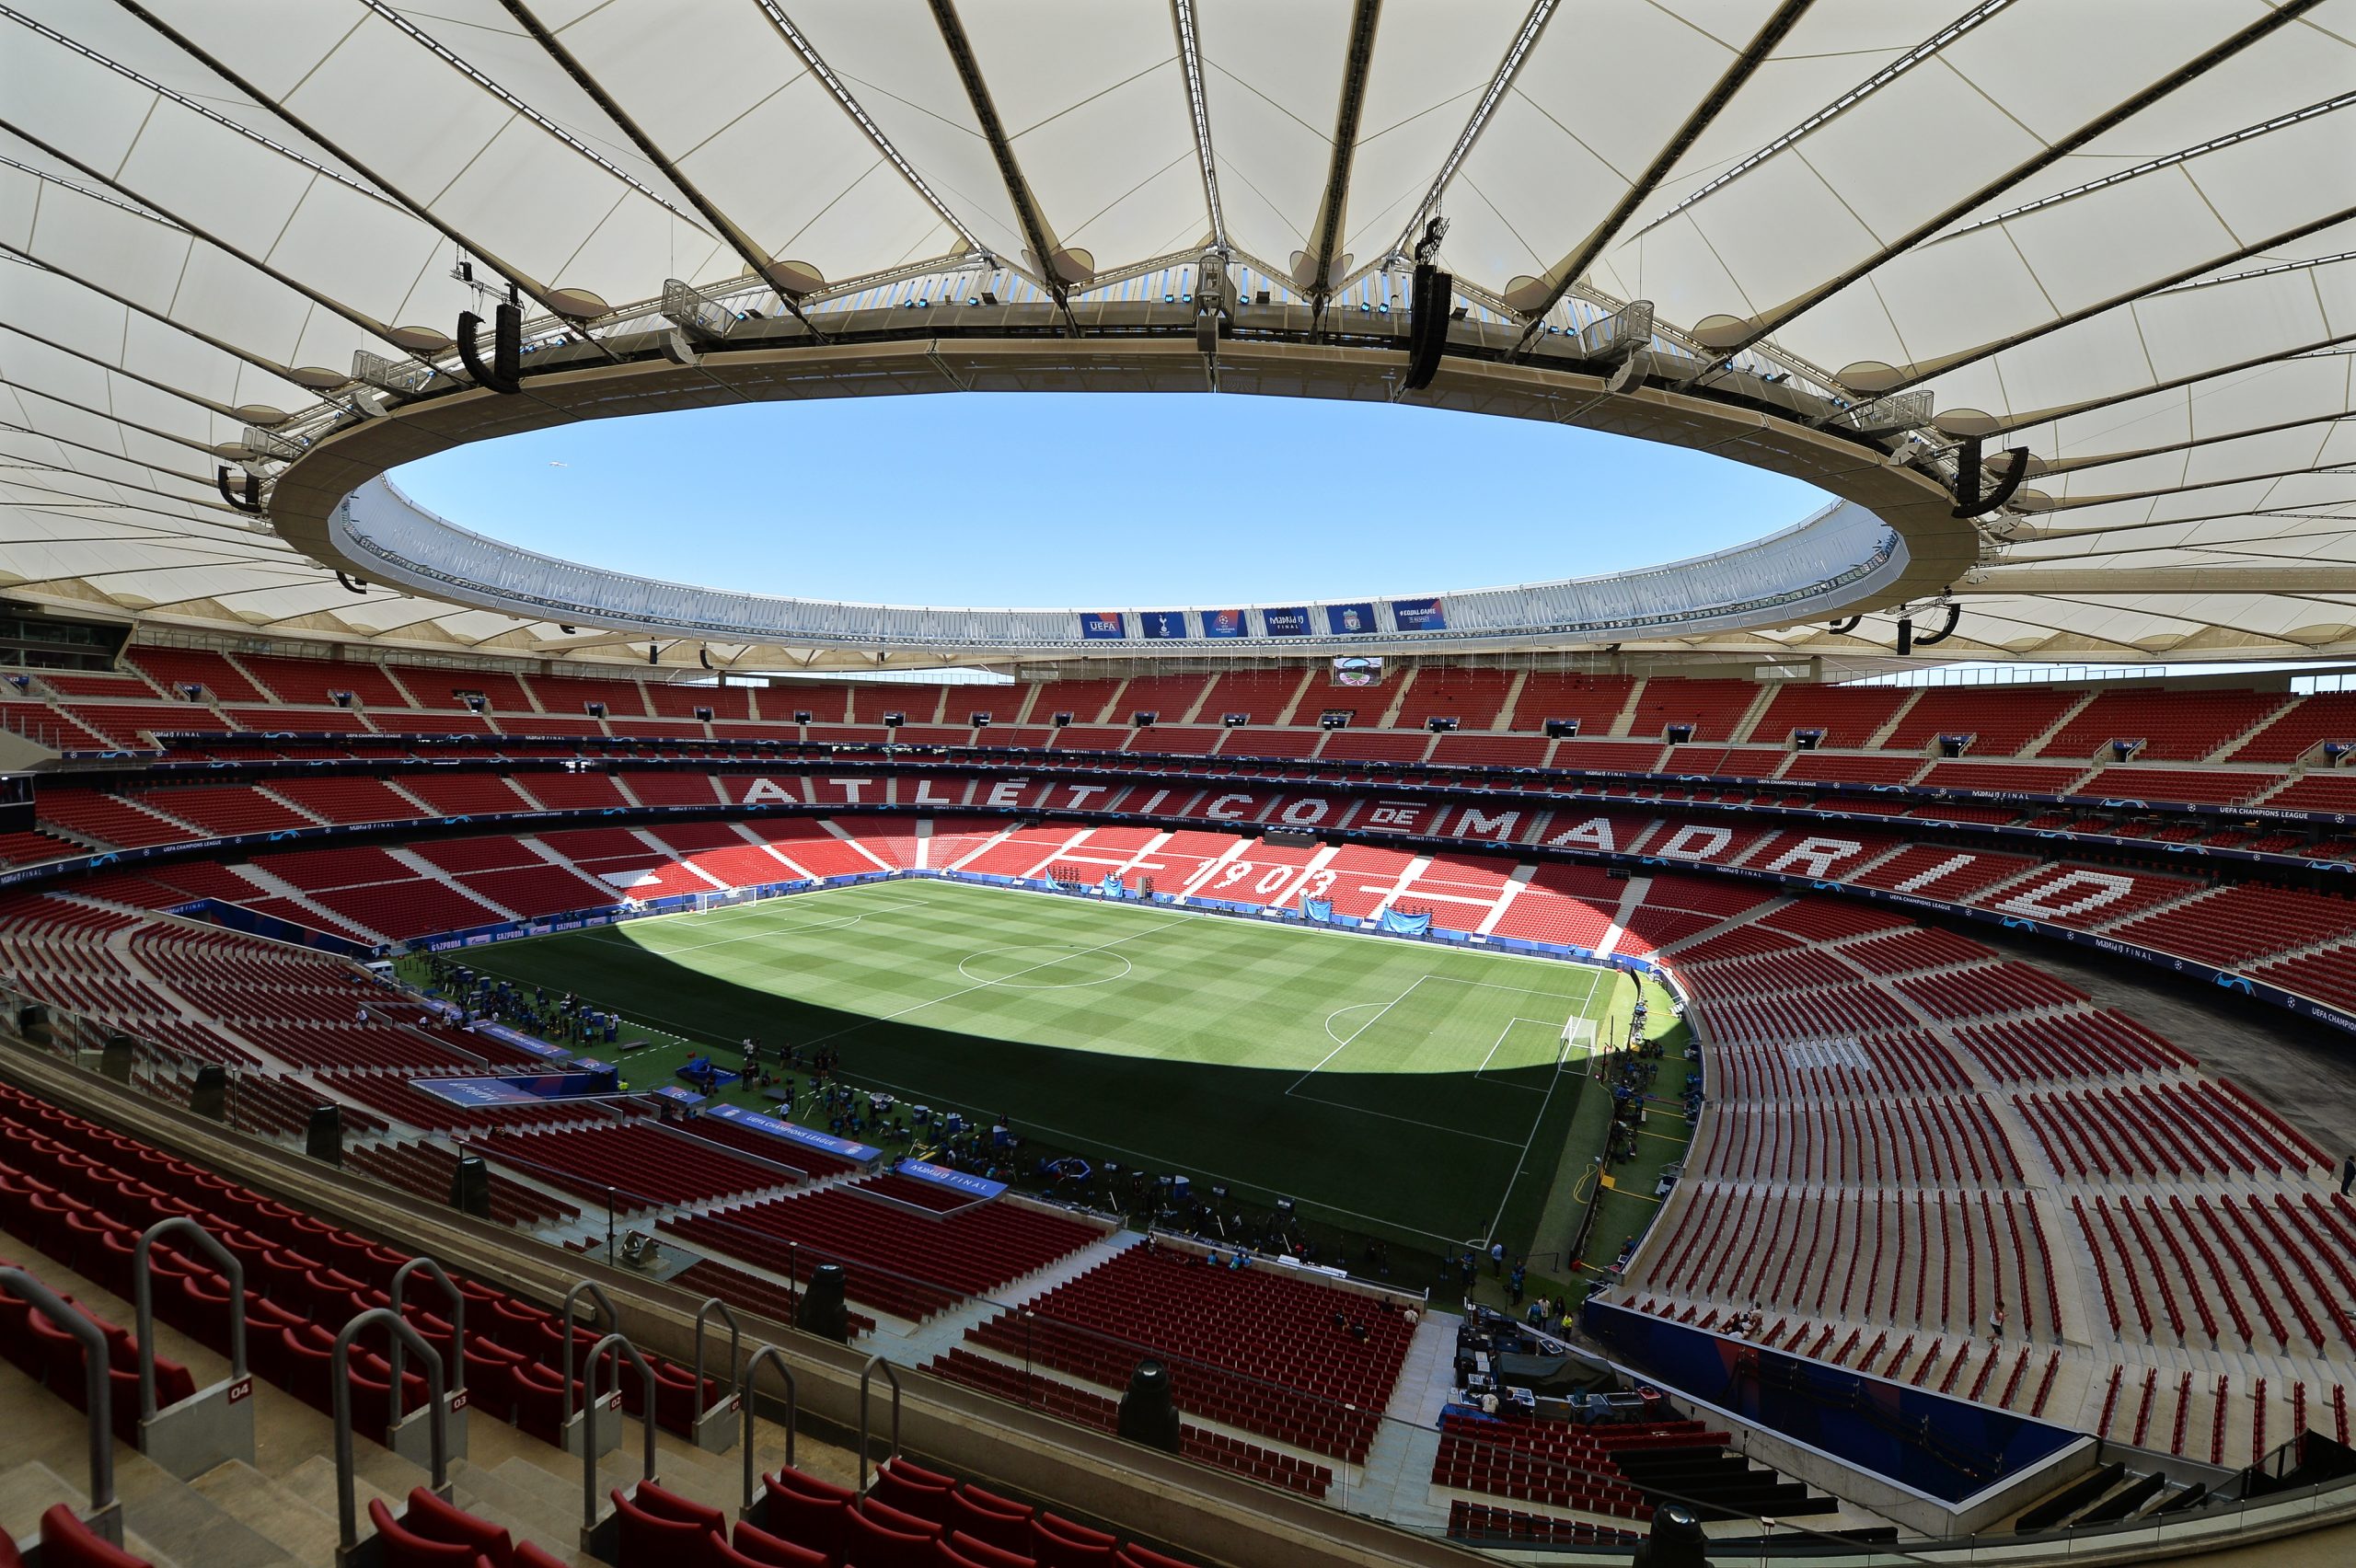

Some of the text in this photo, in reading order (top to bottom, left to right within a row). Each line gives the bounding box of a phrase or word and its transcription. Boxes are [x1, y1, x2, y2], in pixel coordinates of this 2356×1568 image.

[1090, 622, 1116, 631] UEFA
[2238, 808, 2280, 817] CHAMPIONS
[2281, 811, 2309, 820] LEAGUE
[176, 842, 203, 850] CHAMPIONS
[1369, 808, 1419, 825] DE
[1452, 809, 2135, 919] MADRID
[22, 869, 42, 878] FINAL
[1184, 859, 1337, 899] 1903
[1902, 896, 1931, 906] CHAMPIONS
[1932, 903, 1951, 911] LEAGUE
[557, 921, 582, 931] GAZPROM
[497, 930, 524, 940] GAZPROM
[431, 940, 461, 951] GAZPROM
[2125, 947, 2153, 961] FINAL
[2311, 1007, 2327, 1020] UEFA
[746, 1116, 837, 1147] UEFA CHAMPIONS LEAGUE
[950, 1176, 987, 1191] FINAL
[231, 1383, 248, 1399] 04
[454, 1395, 467, 1409] 03
[611, 1396, 621, 1408] 02
[732, 1400, 739, 1411] 01
